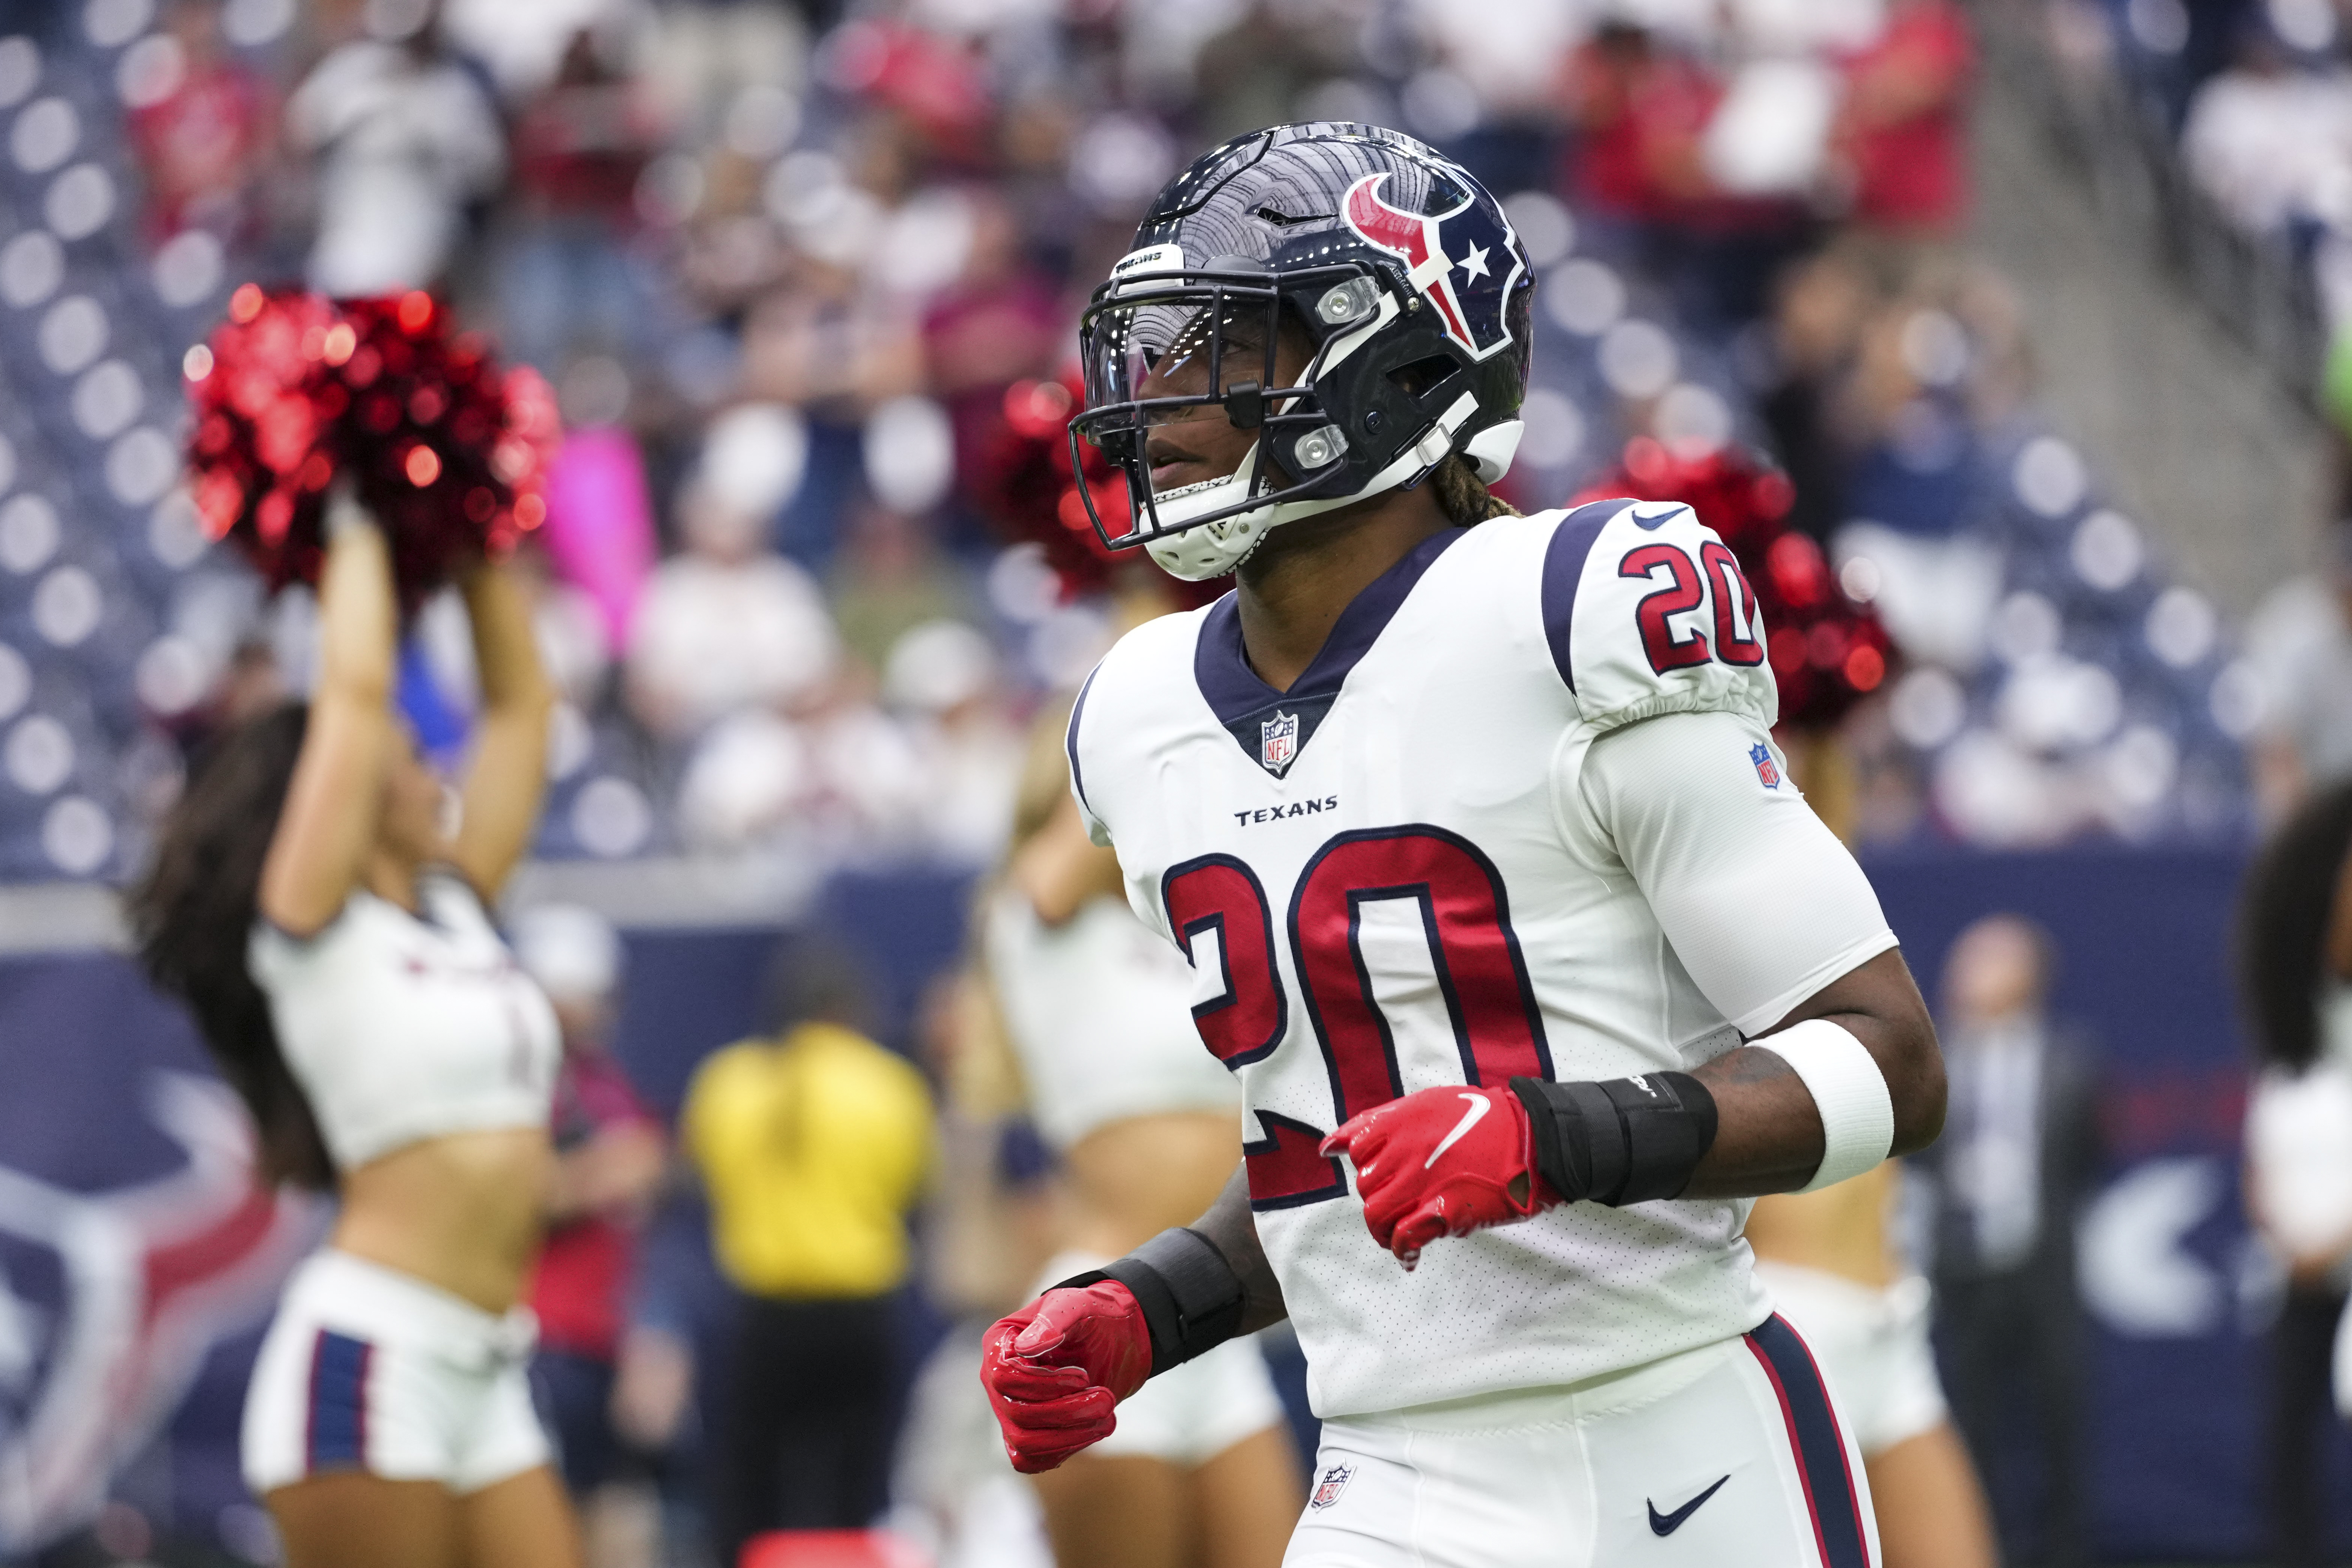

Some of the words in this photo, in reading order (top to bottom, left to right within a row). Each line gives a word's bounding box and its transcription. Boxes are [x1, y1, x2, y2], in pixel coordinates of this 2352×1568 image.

[1618, 540, 1764, 677] 20
[1267, 737, 1290, 761] NFL
[1758, 760, 1778, 784] NFL
[1234, 794, 1339, 827] TEXANS
[1162, 823, 1555, 1211] 20
[1315, 1484, 1339, 1502] NFL
